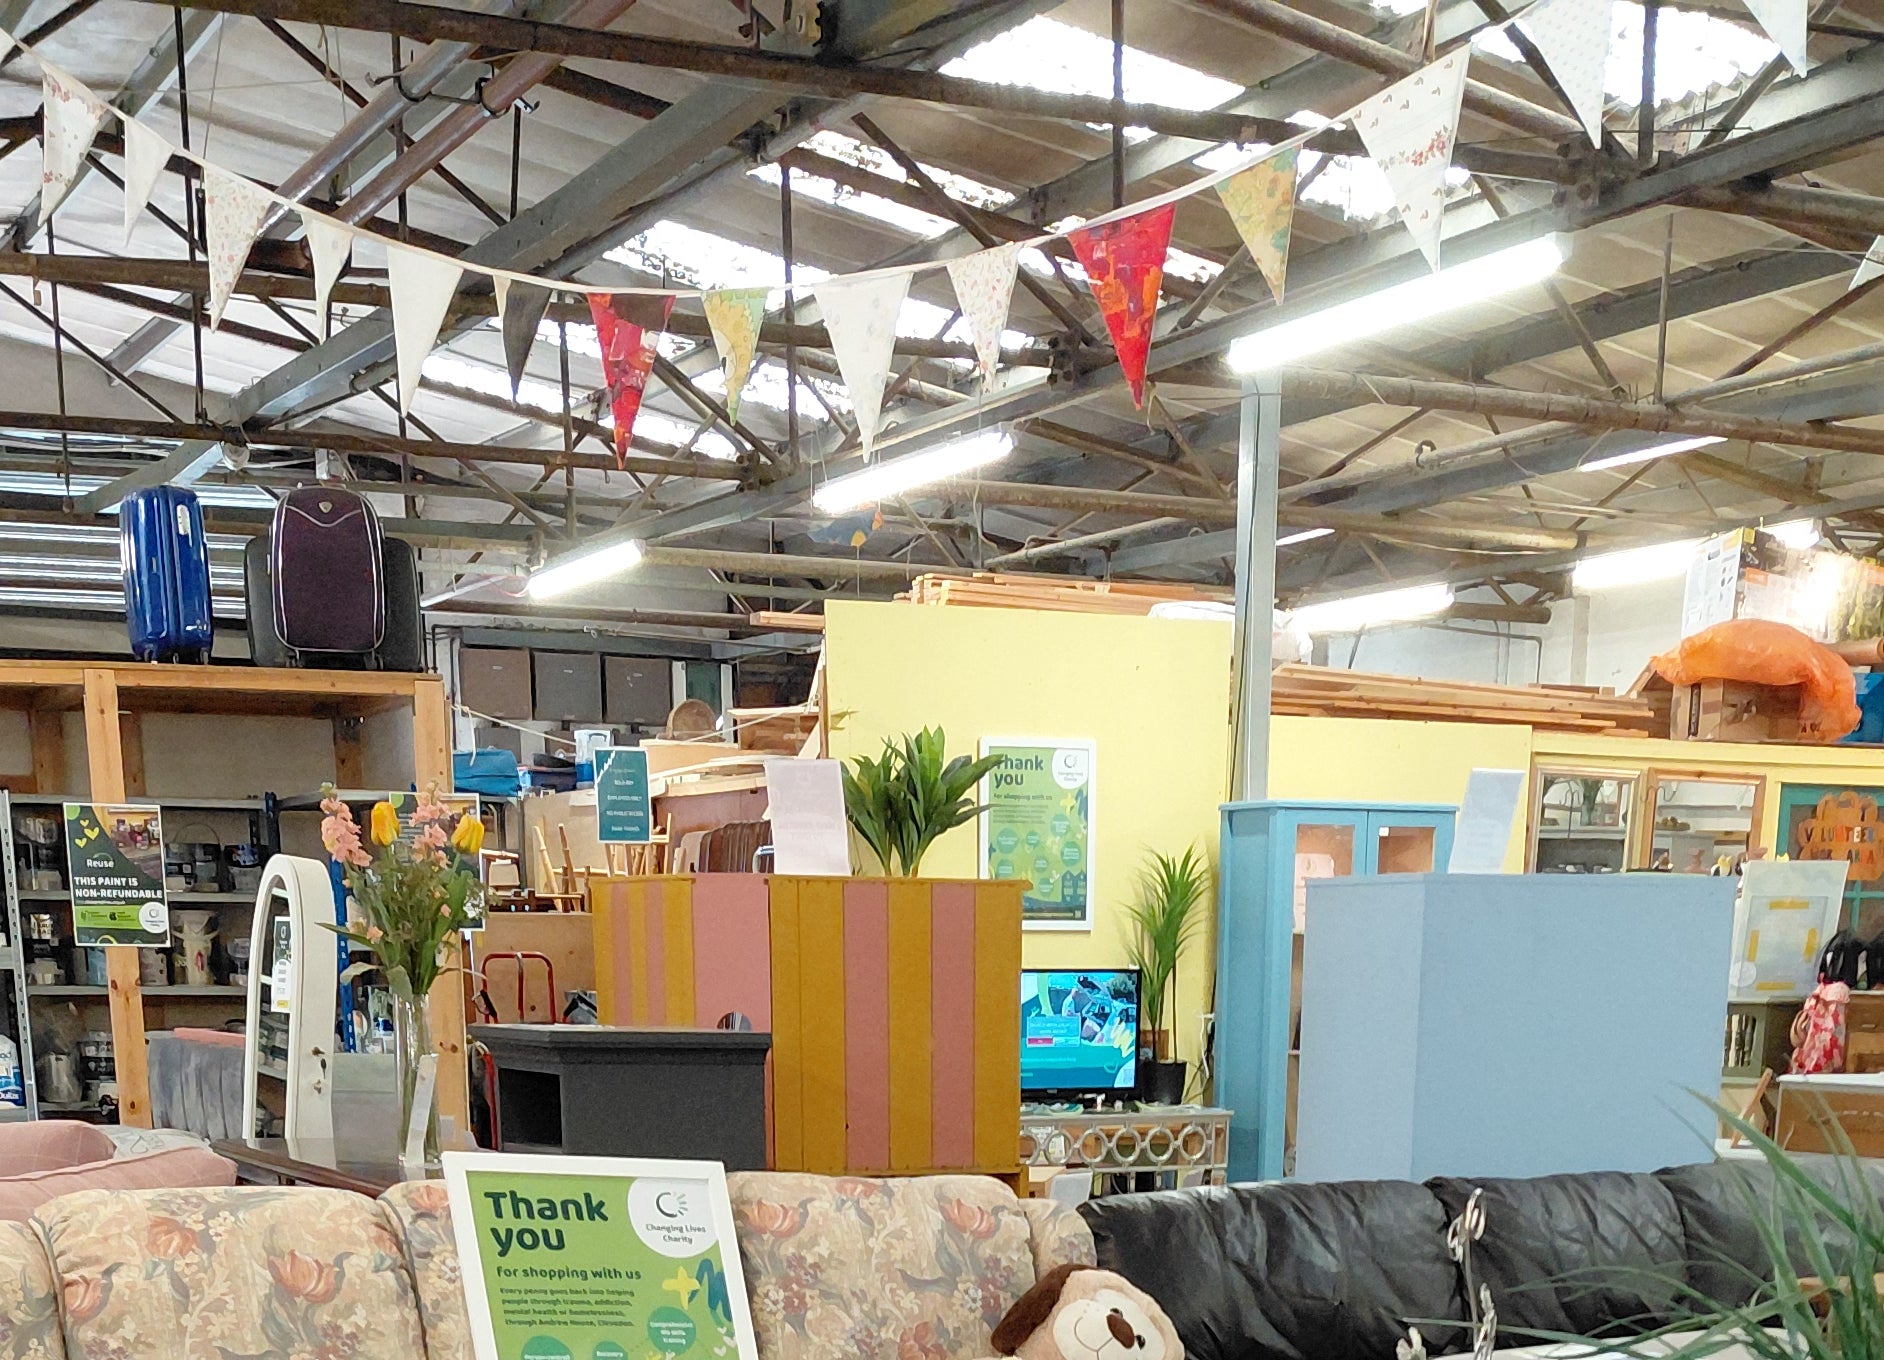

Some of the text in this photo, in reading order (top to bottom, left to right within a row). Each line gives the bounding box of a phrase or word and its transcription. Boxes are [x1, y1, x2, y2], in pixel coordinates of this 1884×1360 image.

[994, 773, 1024, 789] you
[86, 859, 115, 868] Reuse
[74, 876, 139, 887] THIS PAINT IS
[75, 889, 163, 899] NON-REFUNDABLE
[484, 1190, 609, 1222] Thank
[645, 1223, 706, 1234] Changing Lives
[490, 1227, 566, 1258] you
[663, 1235, 693, 1245] Charity
[522, 1266, 588, 1281] shopping
[592, 1267, 622, 1279] with
[625, 1270, 642, 1280] us
